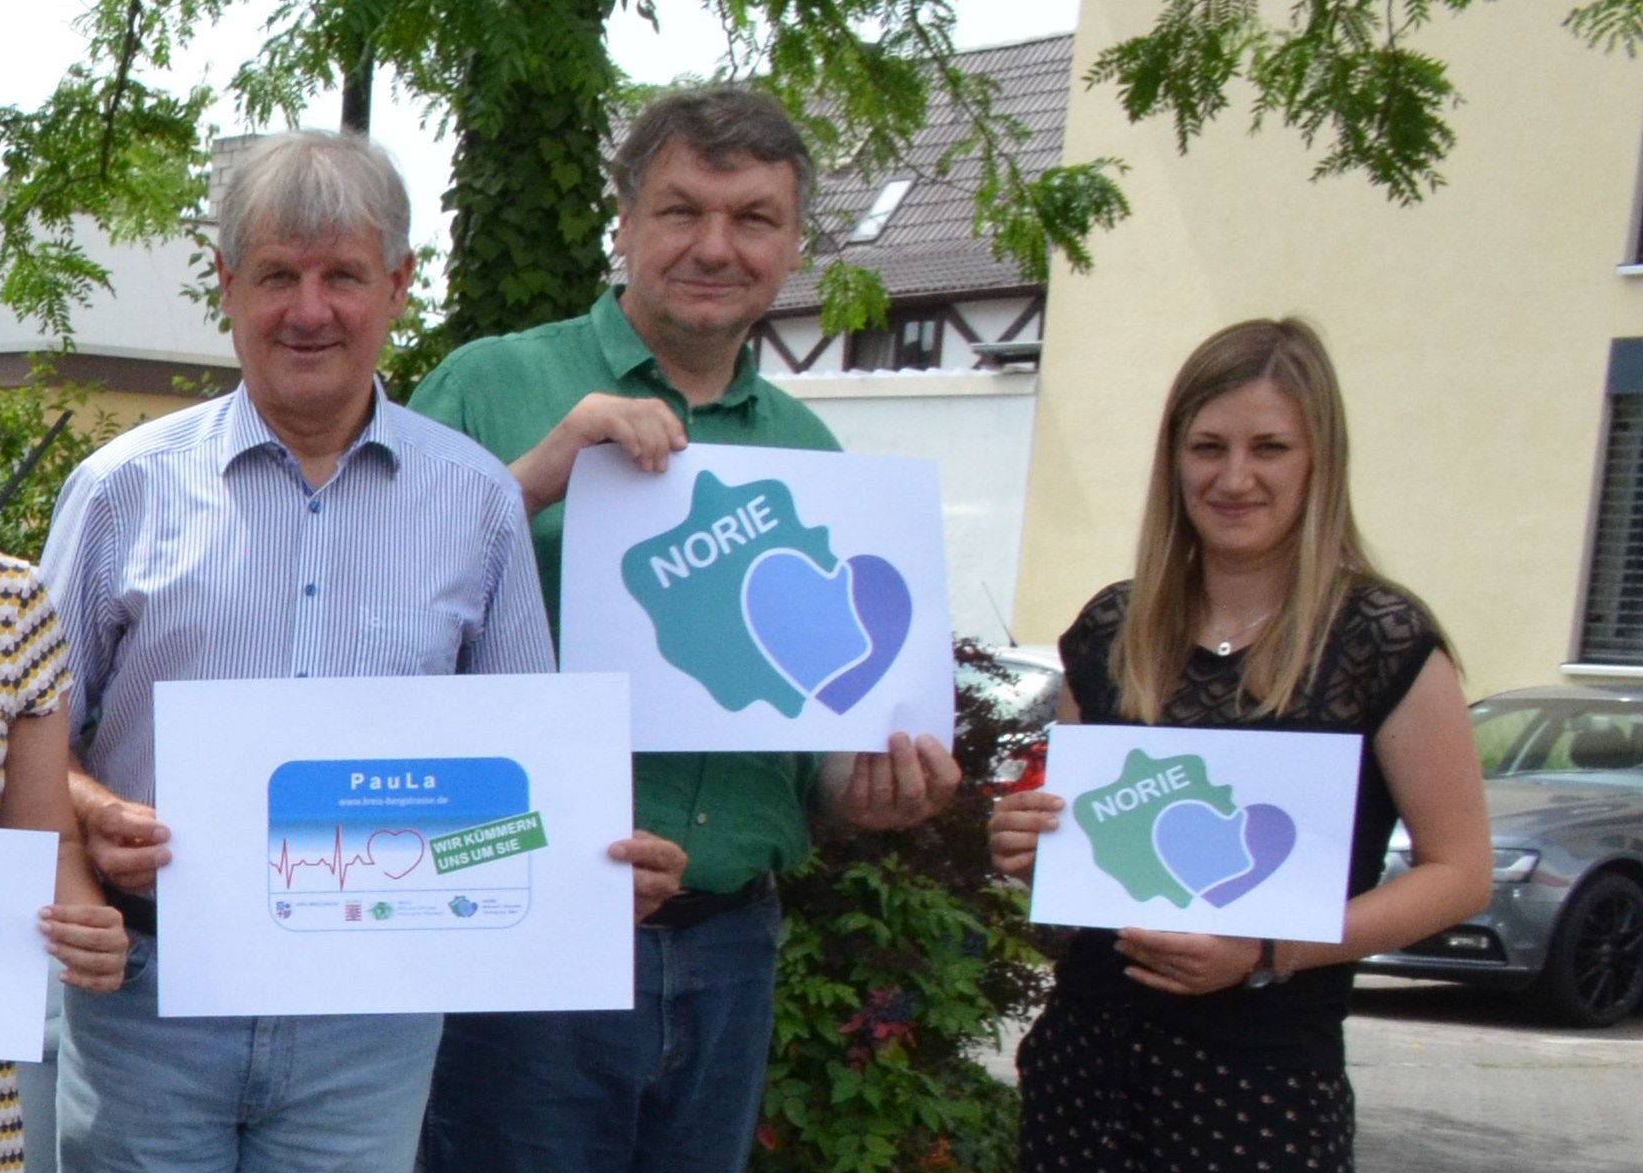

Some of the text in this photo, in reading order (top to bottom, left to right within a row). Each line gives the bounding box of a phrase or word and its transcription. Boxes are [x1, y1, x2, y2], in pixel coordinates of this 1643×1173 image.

[649, 495, 779, 589] NORIE
[351, 772, 436, 790] PauLa
[1091, 765, 1191, 822] NORIE
[433, 816, 538, 854] WIR KÜMMERN
[438, 838, 521, 870] UNS UM SIE
